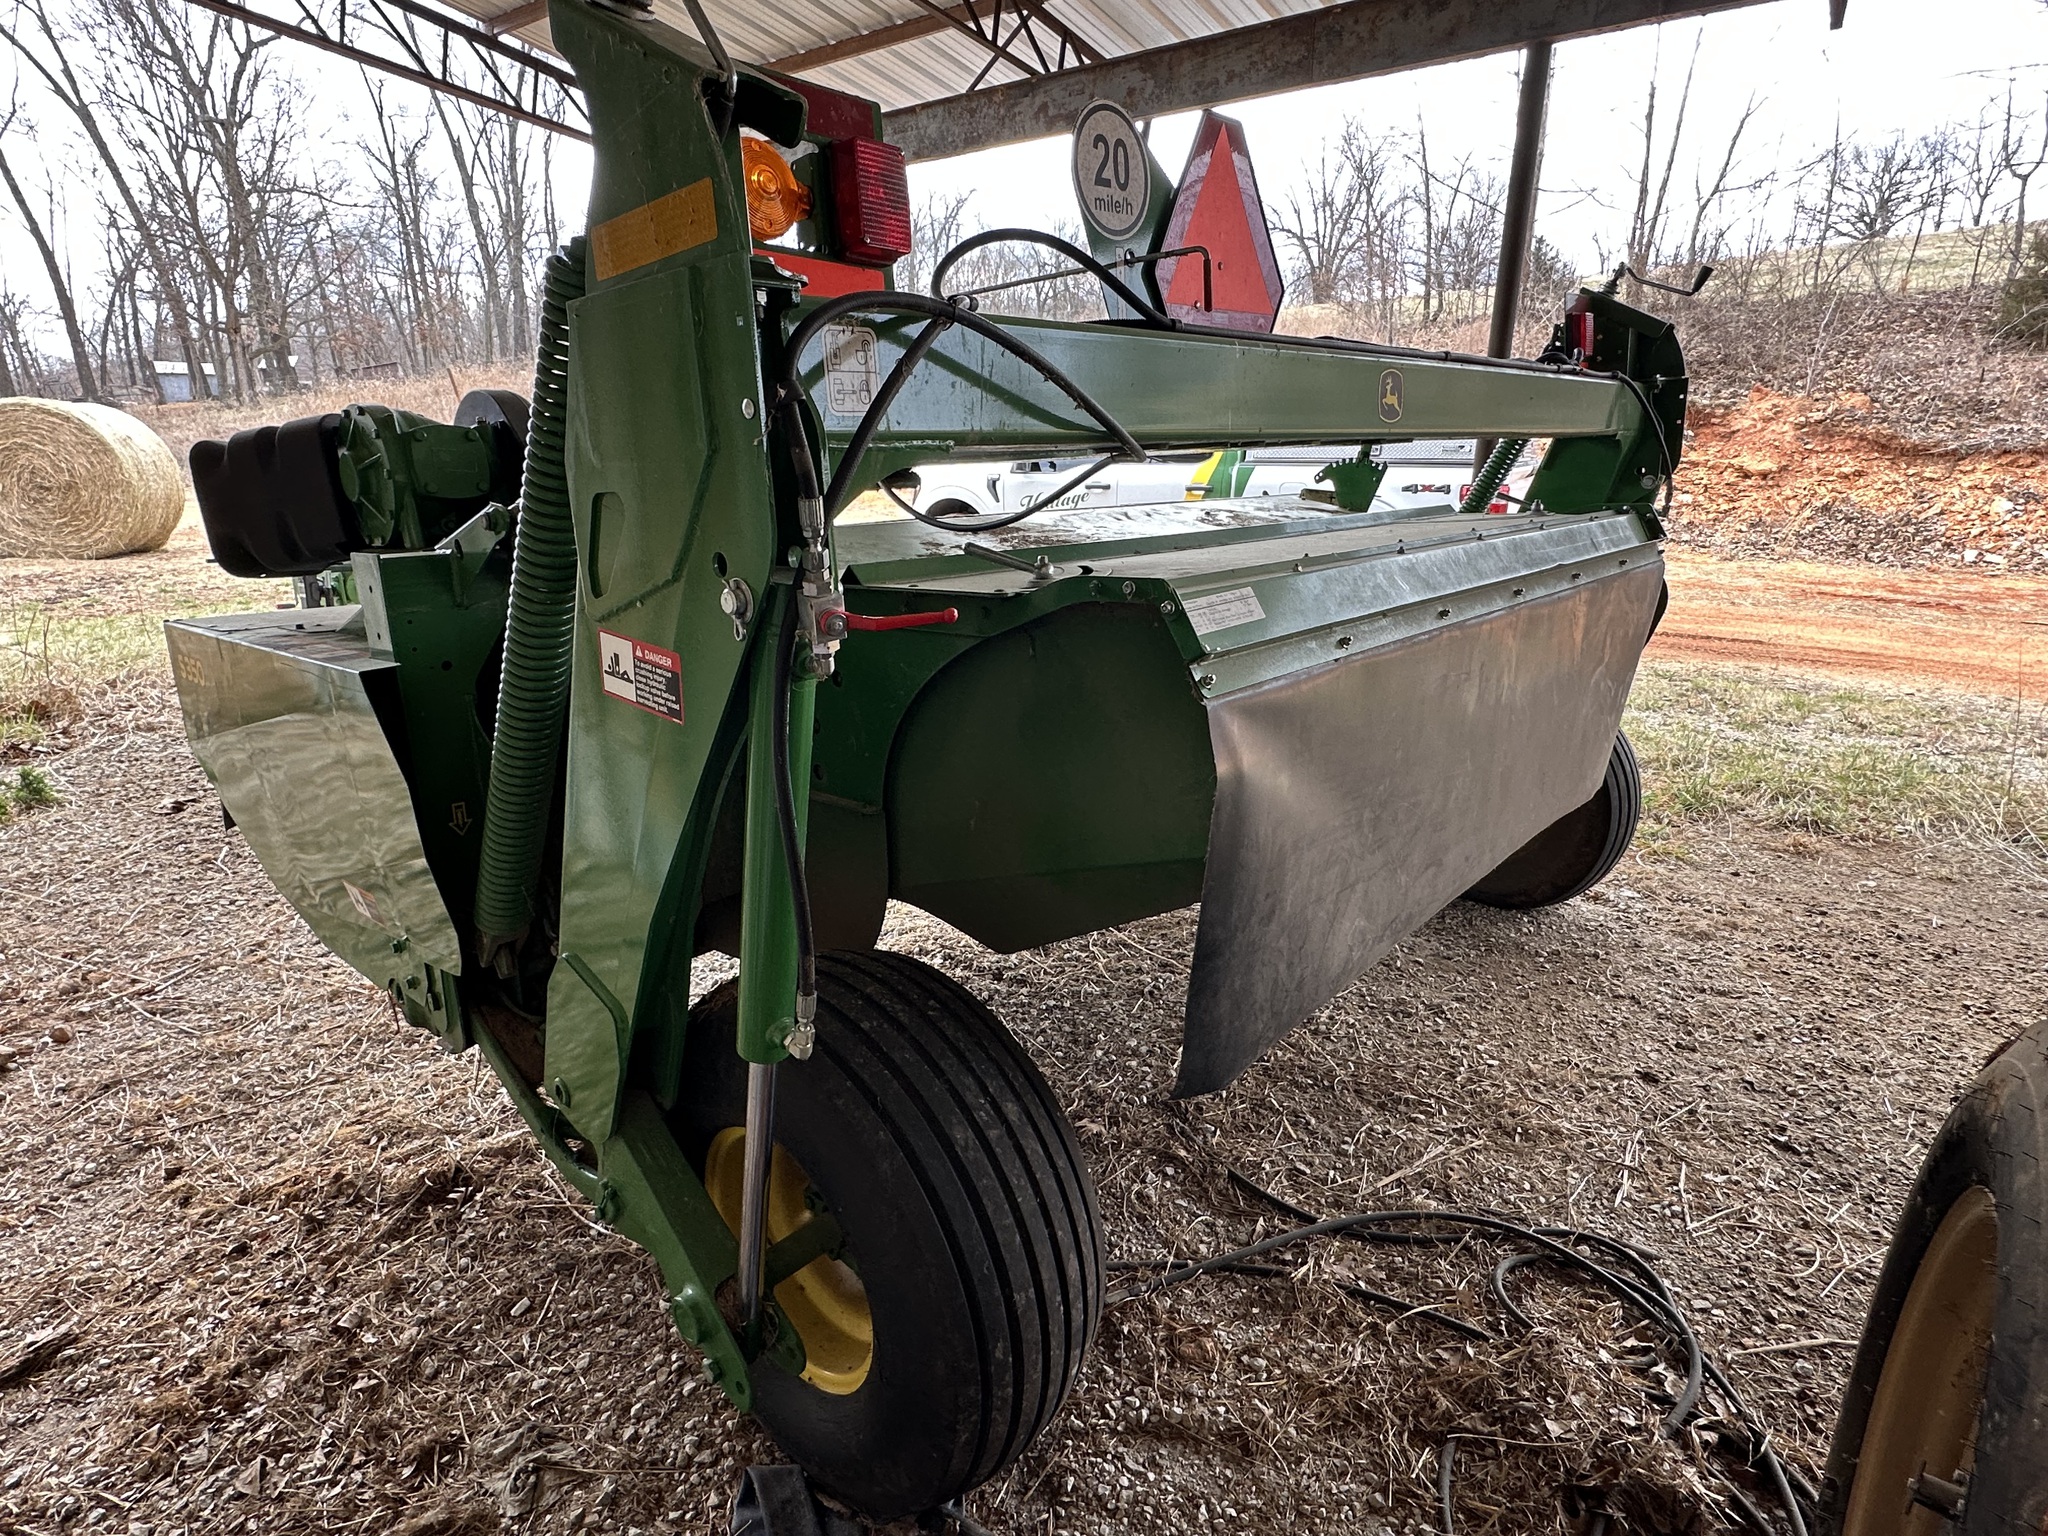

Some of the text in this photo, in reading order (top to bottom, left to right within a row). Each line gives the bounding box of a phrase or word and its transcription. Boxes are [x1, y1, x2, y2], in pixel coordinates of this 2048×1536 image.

[1092, 133, 1130, 192] 20
[1094, 194, 1134, 216] mile/h
[644, 649, 672, 668] DANGER
